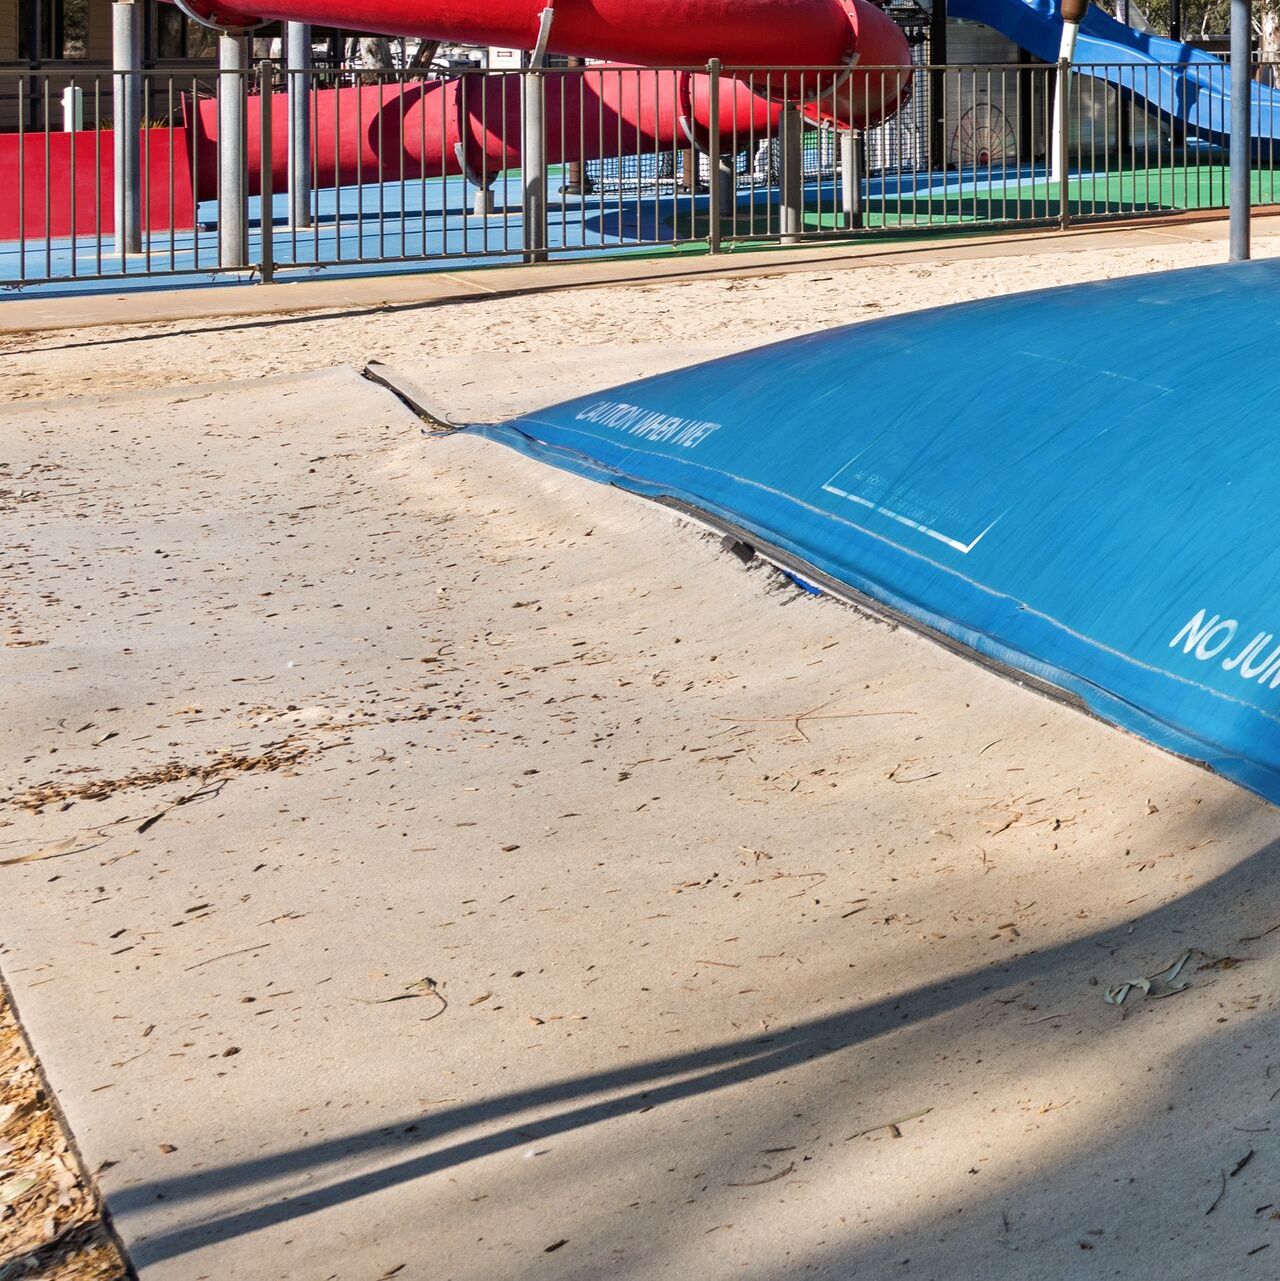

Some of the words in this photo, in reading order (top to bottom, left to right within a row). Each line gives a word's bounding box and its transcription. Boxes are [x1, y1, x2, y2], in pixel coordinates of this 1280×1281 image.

[575, 401, 642, 431] CAUTION
[628, 410, 684, 442] WHEN
[671, 419, 722, 448] WET
[1169, 608, 1238, 661] NO
